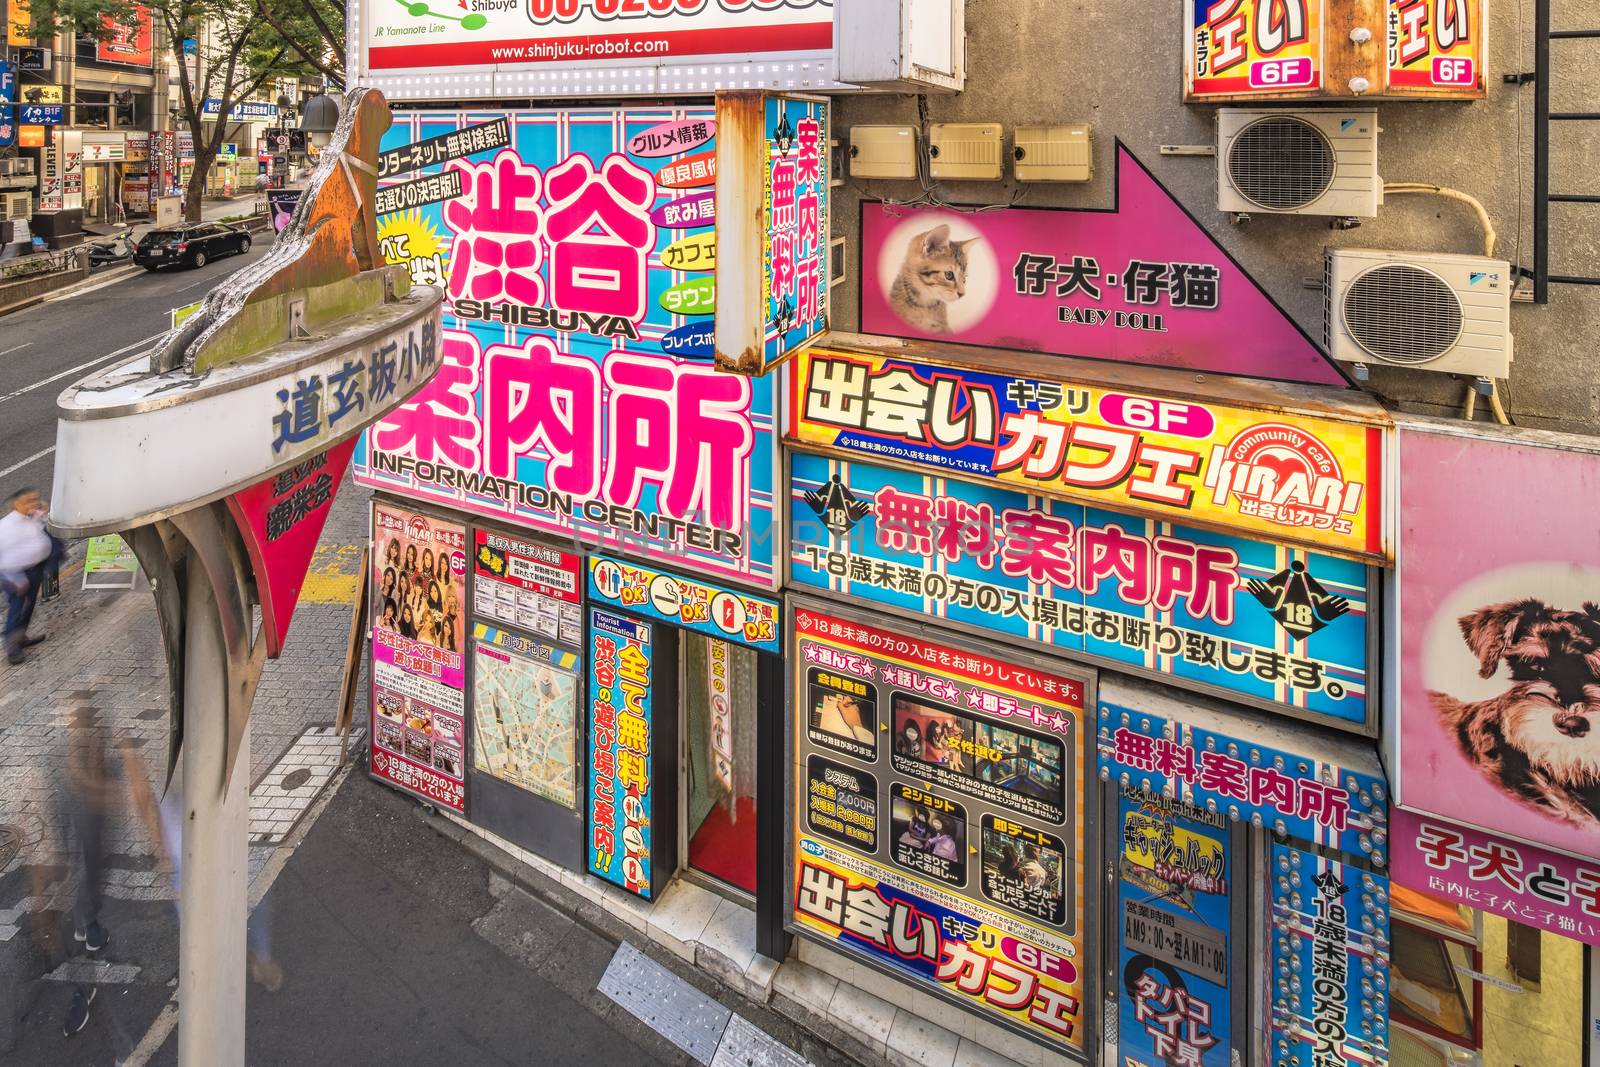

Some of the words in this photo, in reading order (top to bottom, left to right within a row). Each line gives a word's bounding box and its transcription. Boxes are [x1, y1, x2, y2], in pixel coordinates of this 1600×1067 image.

[472, 0, 517, 13] Shibuya
[374, 27, 384, 37] JR
[387, 24, 427, 36] Yamanote
[429, 23, 445, 34] Line
[492, 39, 669, 59] www.shinjuku-robot.com
[1389, 11, 1398, 67] キラリ
[1197, 30, 1209, 77] キラリ
[1261, 61, 1300, 83] 6F
[1439, 61, 1465, 82] 6F
[45, 107, 60, 115] B1F
[633, 123, 708, 153] グルメ情報
[444, 150, 656, 318] 渋谷
[771, 157, 797, 301] 無料
[797, 117, 819, 329] 案内所
[454, 299, 639, 339] SHIBUYA
[1057, 306, 1109, 326] BABY
[1115, 312, 1168, 333] DOLL
[272, 319, 436, 453] 道玄坂小路
[804, 357, 995, 447] 出会い
[1007, 380, 1090, 415] キラリ
[1121, 398, 1188, 431] 6F
[995, 411, 1200, 506] カフェ
[1234, 430, 1306, 460] community
[1308, 445, 1330, 474] cafe
[1204, 444, 1364, 515] KIRARI
[372, 450, 573, 518] INFORMATION
[582, 499, 742, 558] CENTER
[827, 508, 846, 525] 18
[1240, 498, 1352, 534] 出会いカフェ
[621, 567, 648, 583] トイレ
[874, 485, 1240, 626] 無料案内所
[621, 586, 646, 603] OK
[679, 582, 708, 600] タバコ
[682, 604, 706, 620] OK
[746, 601, 773, 619] 充電
[596, 613, 620, 627] Tourist
[596, 621, 635, 638] Information
[744, 622, 770, 638] OK
[806, 547, 1345, 699] 18歳未満の方の入場はお断り致します。
[1283, 602, 1313, 625] 18
[813, 618, 1078, 700] 18歳未満の方の入店をお断りしています。
[618, 644, 649, 794] 全て無料
[896, 669, 943, 697] 話して
[981, 692, 1049, 727] 即デート
[902, 787, 955, 812] 2ショット
[1114, 728, 1349, 832] 無料案内所
[993, 819, 1051, 845] 即デート
[1124, 818, 1224, 881] キャッシュバック
[1325, 884, 1336, 895] 18
[797, 864, 939, 960] 出会い
[1126, 901, 1174, 927] 営業時間
[943, 916, 995, 949] キラリ
[1016, 945, 1060, 972] 6F
[938, 941, 1077, 1035] カフェ
[1136, 975, 1210, 1026] タバコ
[1136, 996, 1214, 1046] トイレ
